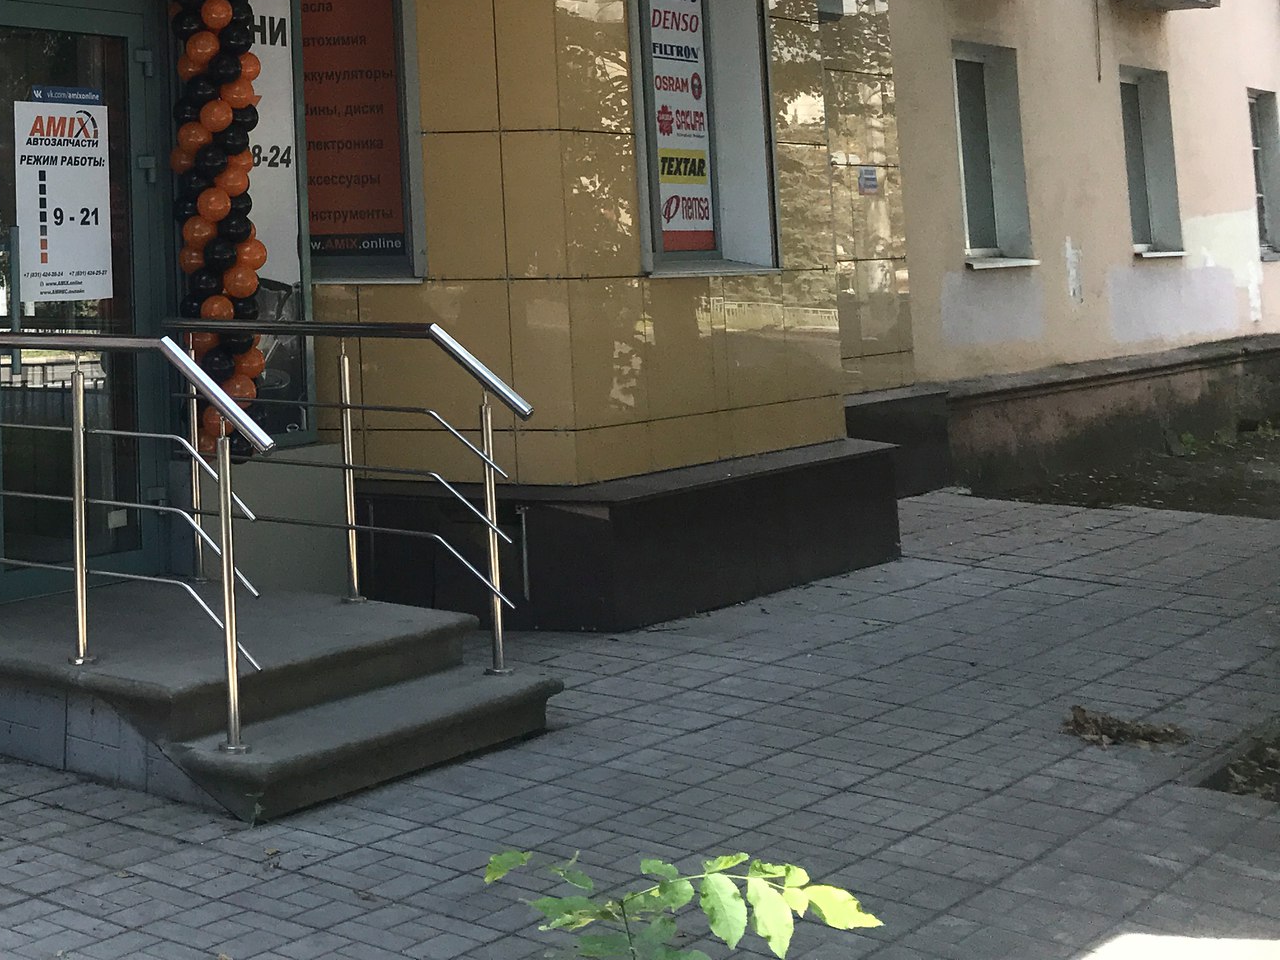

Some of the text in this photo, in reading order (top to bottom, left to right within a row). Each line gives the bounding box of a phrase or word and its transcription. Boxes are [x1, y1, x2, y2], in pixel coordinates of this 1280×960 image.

[651, 9, 699, 33] DENSO
[652, 42, 699, 60] FILTRON
[654, 75, 689, 93] OSRAM
[345, 102, 384, 117] диски
[29, 115, 91, 139] AMIX
[26, 138, 99, 148] АВТОЗАПЧАСТИ
[20, 154, 106, 167] РЕЖИМ РАБОТЫ:
[660, 156, 706, 177] TEXTAR
[53, 207, 64, 226] 9
[80, 207, 100, 226] 21
[309, 207, 394, 223] нструменты
